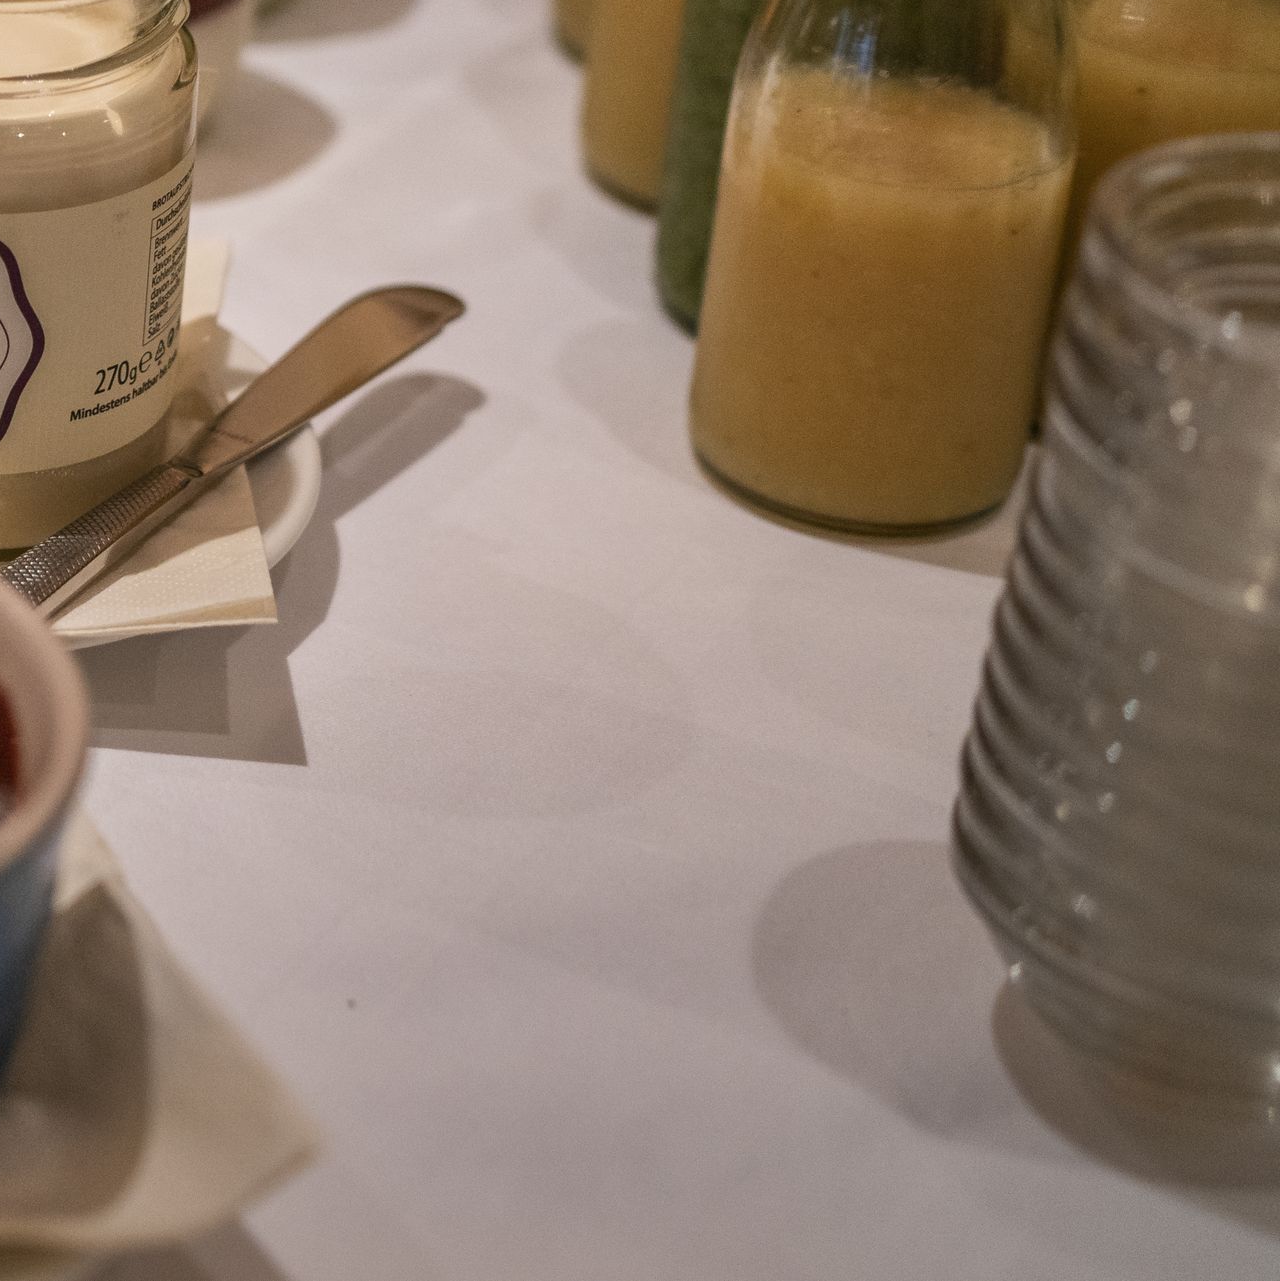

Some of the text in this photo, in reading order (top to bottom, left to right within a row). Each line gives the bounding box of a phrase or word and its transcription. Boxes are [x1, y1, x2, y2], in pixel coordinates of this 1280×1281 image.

[69, 393, 131, 422] Mindestens
[131, 374, 159, 400] haltbar
[94, 360, 137, 395] 270g
